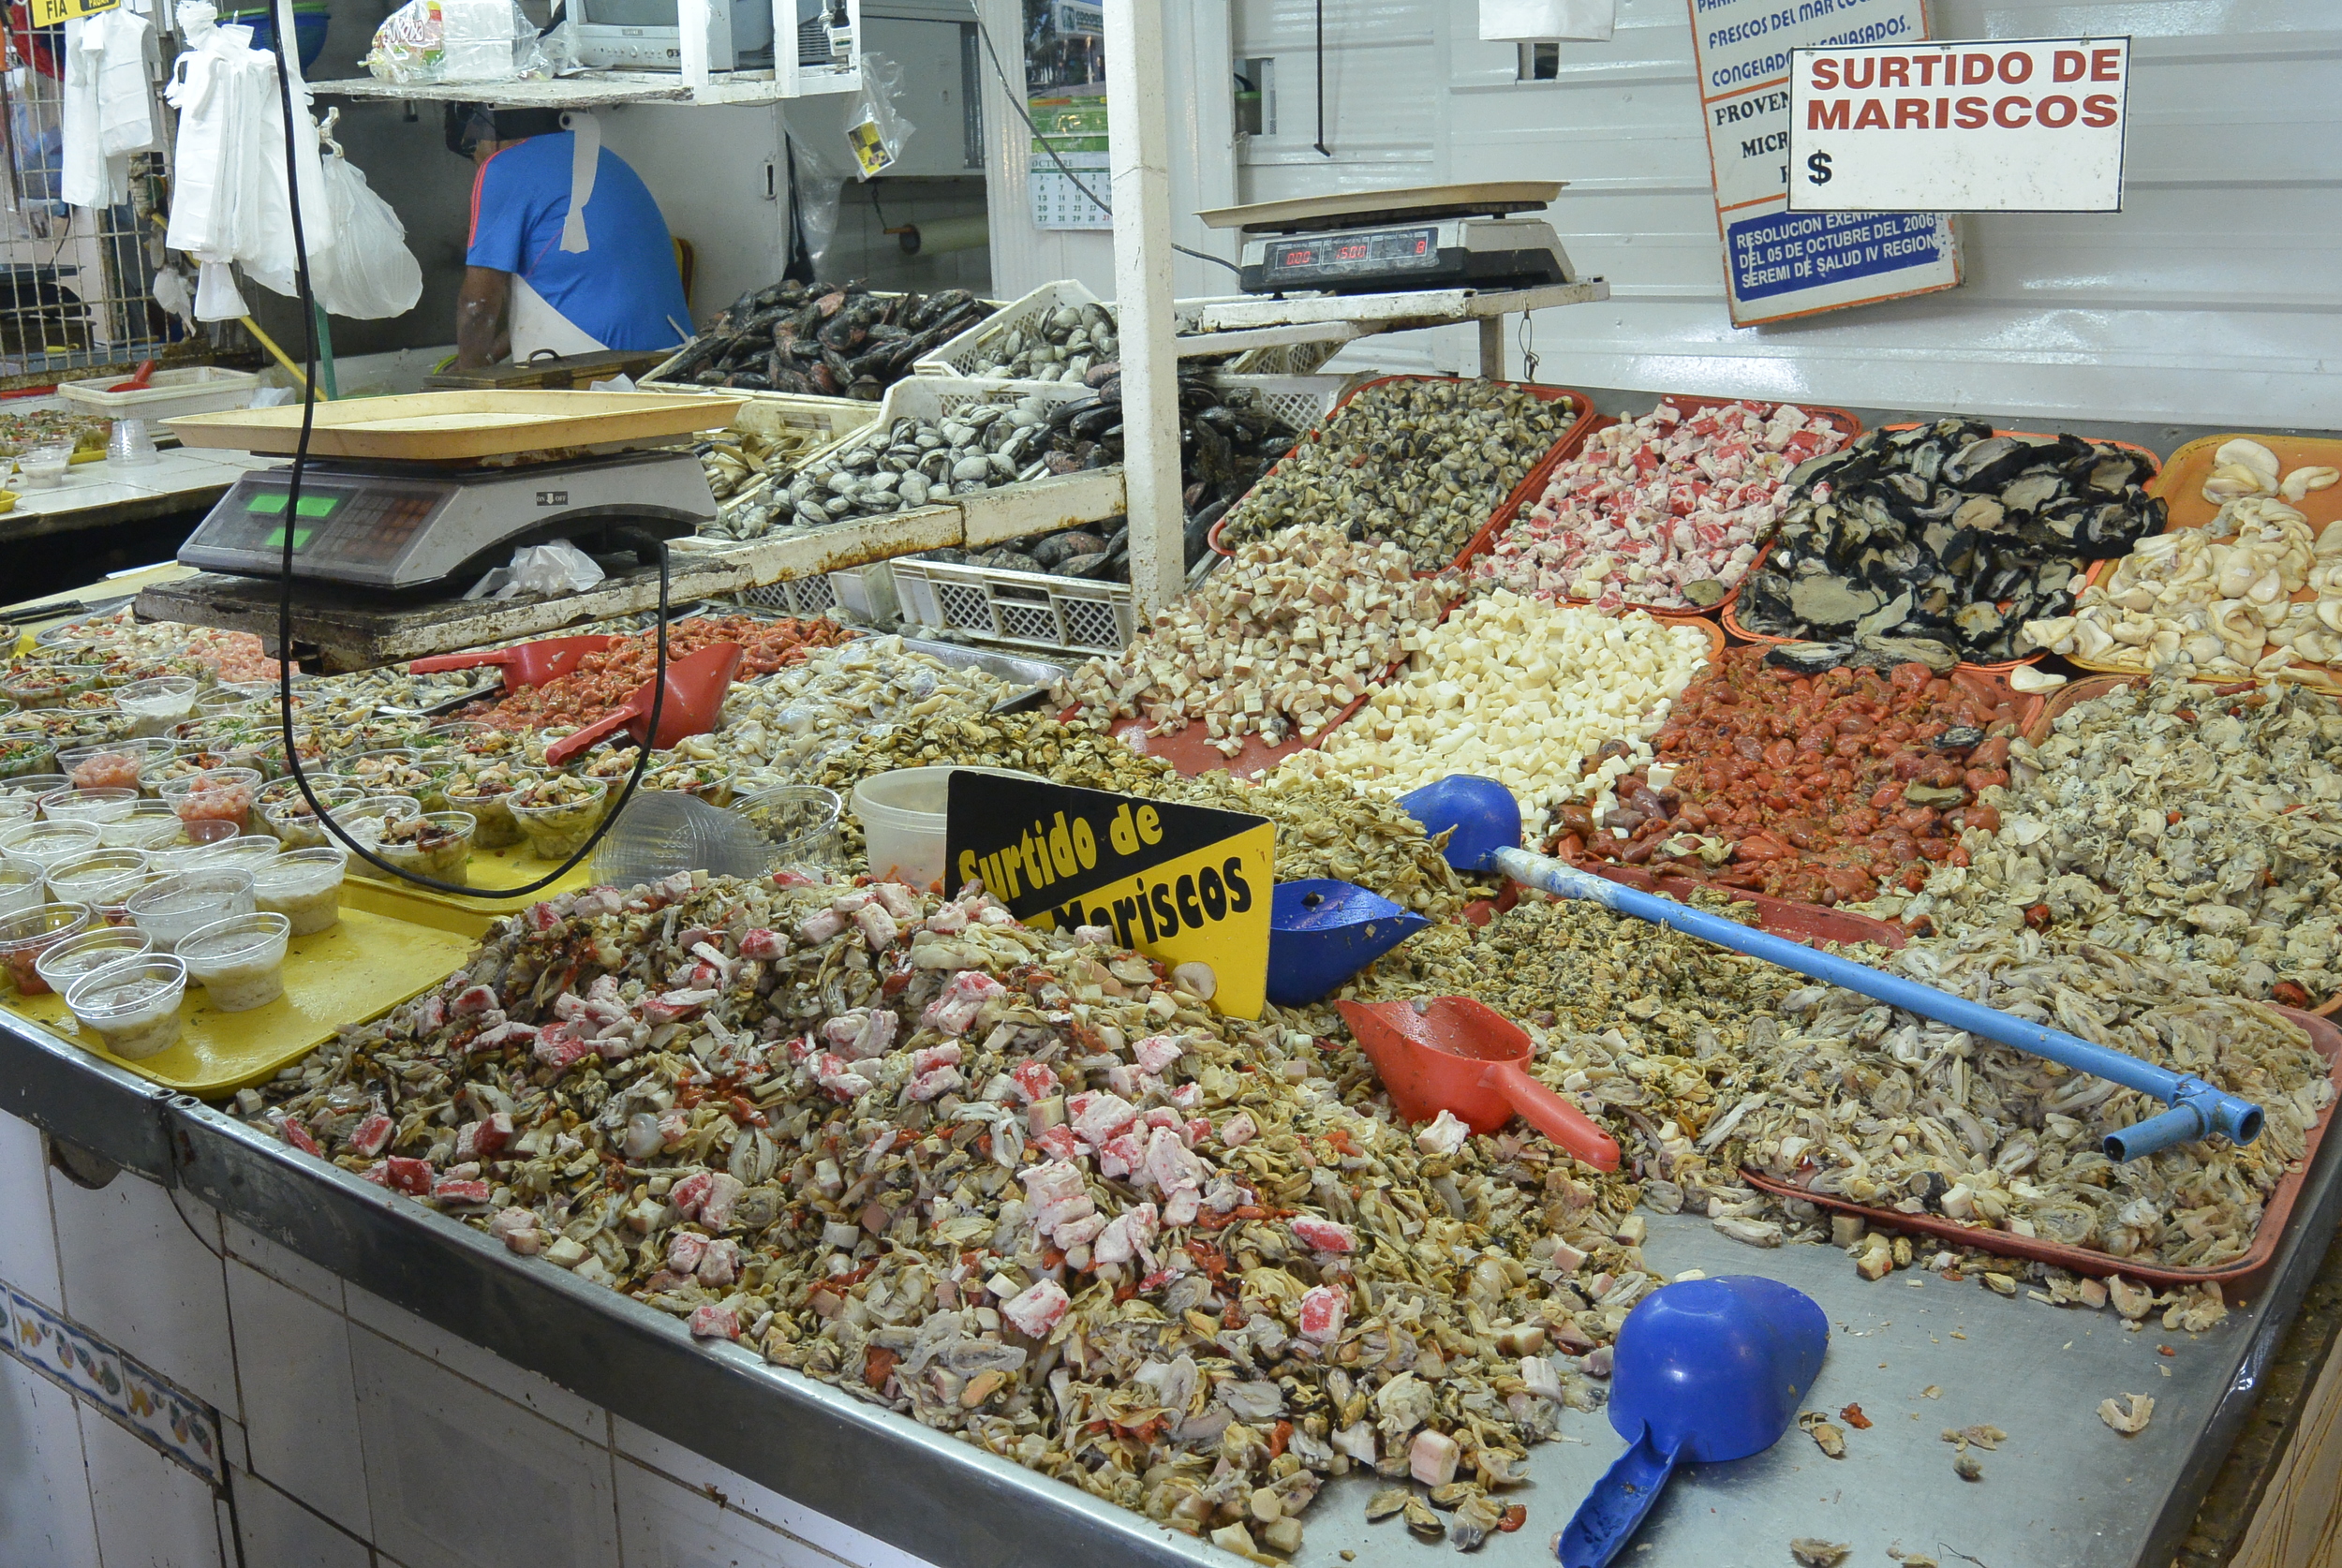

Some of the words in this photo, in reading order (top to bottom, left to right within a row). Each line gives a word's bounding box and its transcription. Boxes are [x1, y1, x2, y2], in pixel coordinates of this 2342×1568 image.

[46, 0, 67, 20] FIA
[1709, 17, 1768, 50] FRESCOS
[1771, 8, 1796, 31] DEL
[1799, 0, 1834, 22] MAR
[1810, 51, 2034, 91] SURTIDO
[2053, 48, 2121, 83] DE
[1806, 94, 2119, 130] MARISCOS
[1031, 159, 1074, 168] OCTURE
[1806, 149, 1833, 186] $
[1736, 216, 1822, 249] RESOLUCION
[1739, 251, 1765, 269] DEL
[1767, 246, 1783, 262] 05
[1785, 242, 1803, 259] DE
[1806, 226, 1871, 254] OCTUBRE
[1874, 220, 1901, 240] DEL
[1904, 213, 1934, 233] 2006
[1742, 264, 1790, 288] SEREMI
[1794, 259, 1813, 277] DE
[1816, 249, 1861, 273] SALUD
[1865, 245, 1878, 262] IV
[1883, 233, 1936, 259] REGION
[958, 810, 1097, 903] Surtido
[1109, 803, 1164, 856] de
